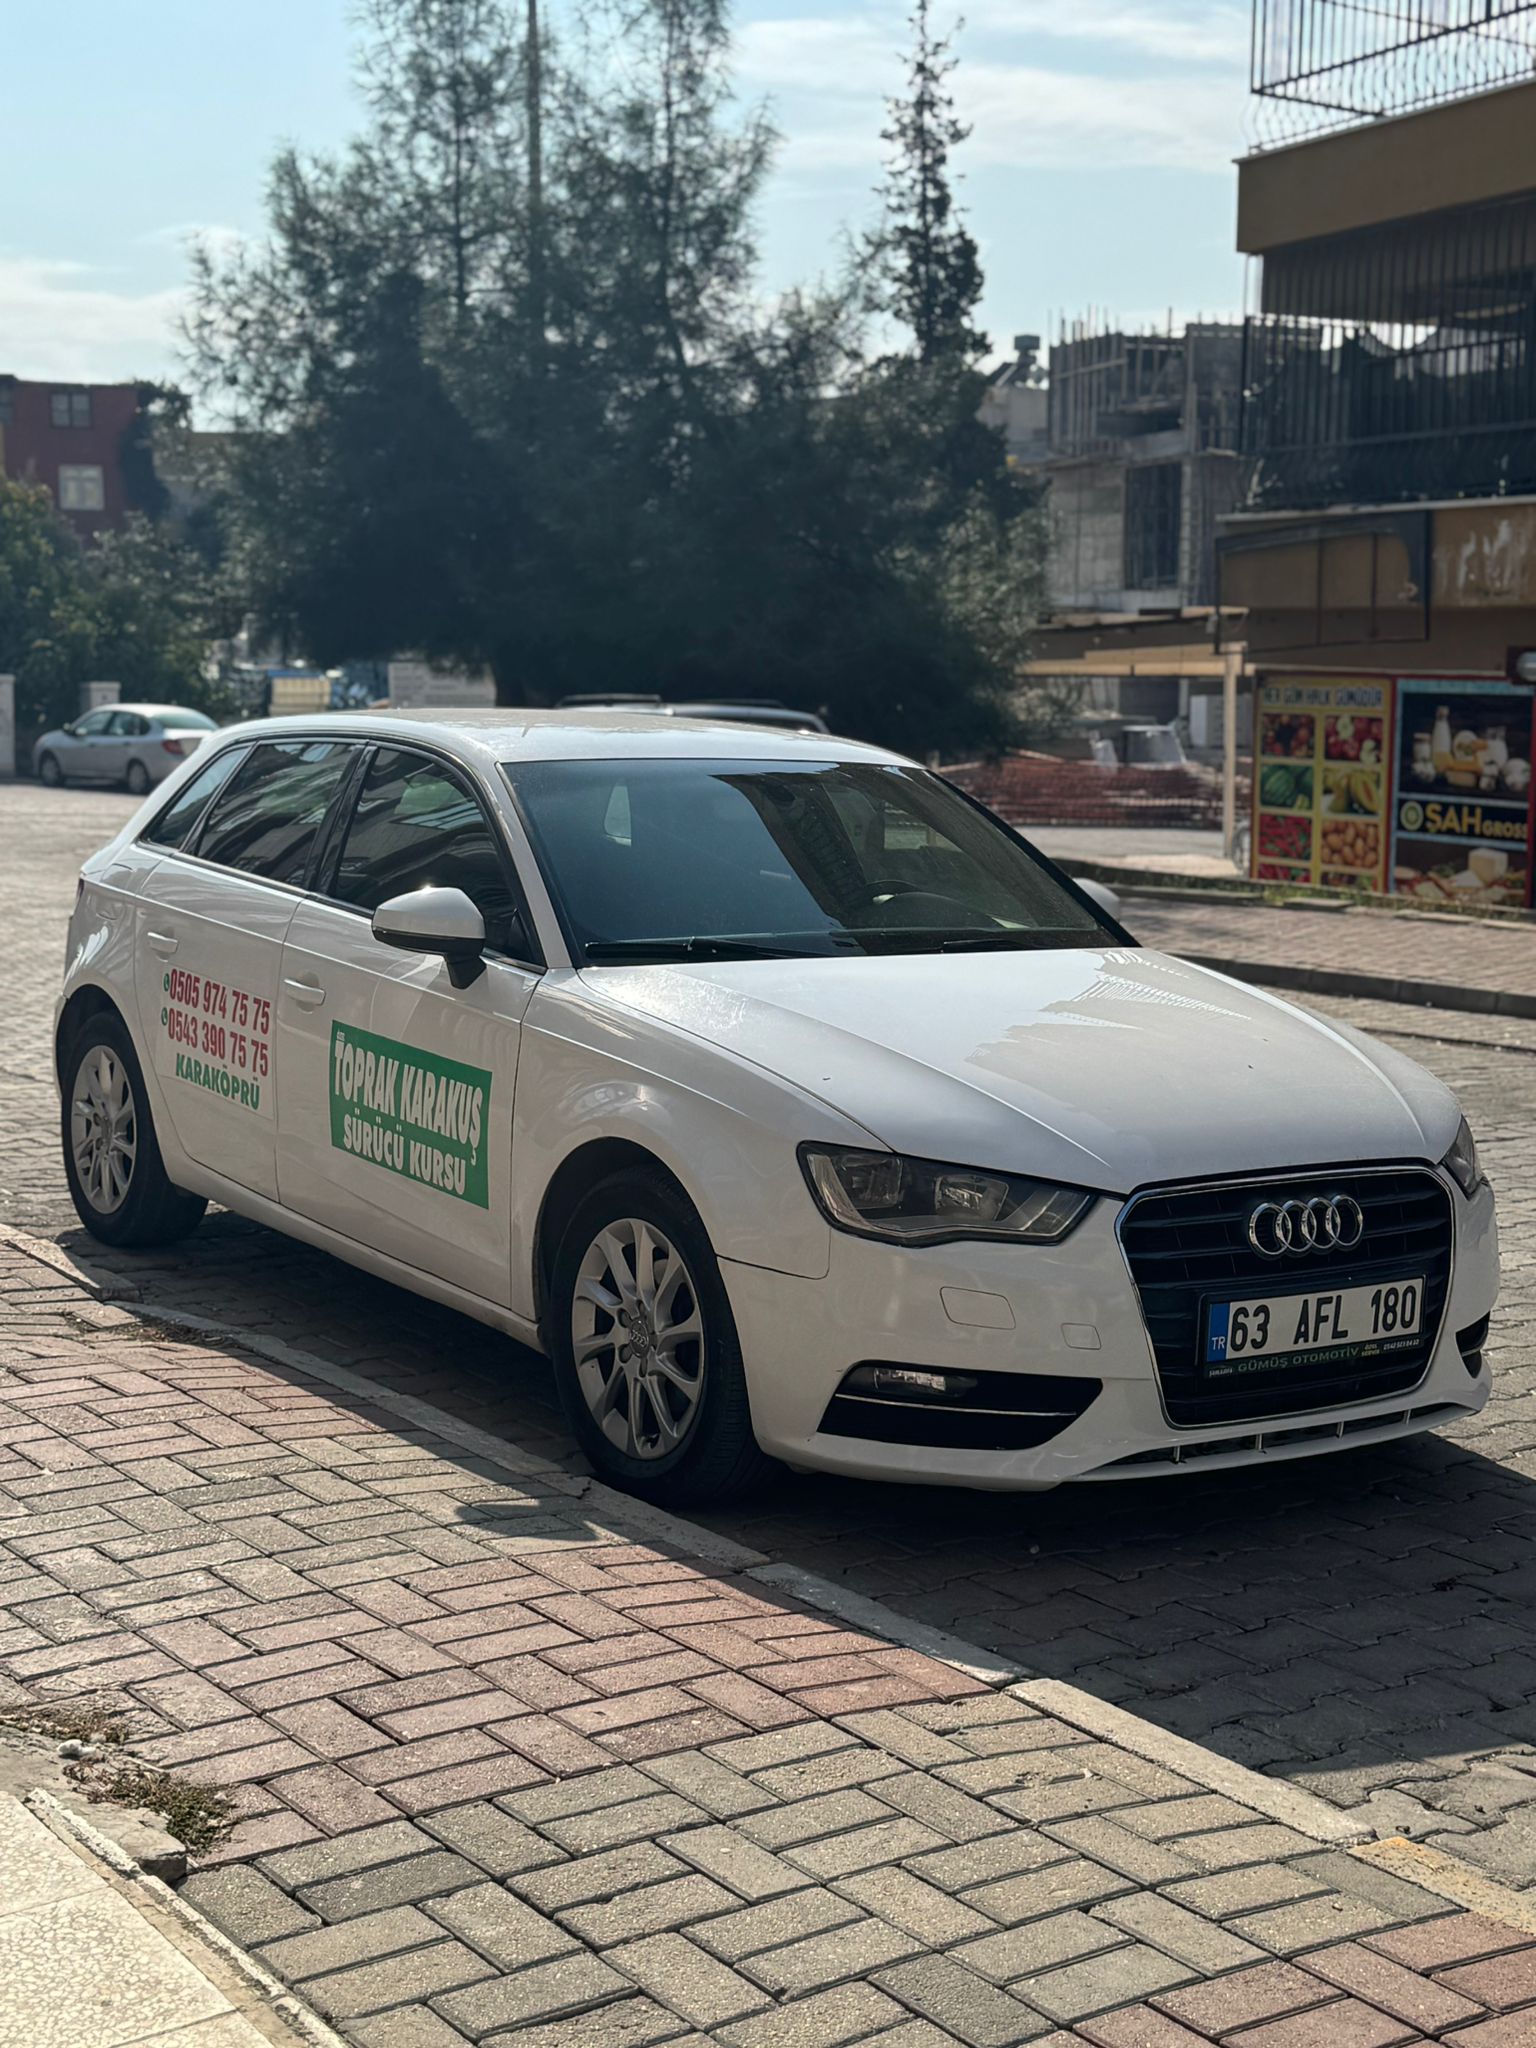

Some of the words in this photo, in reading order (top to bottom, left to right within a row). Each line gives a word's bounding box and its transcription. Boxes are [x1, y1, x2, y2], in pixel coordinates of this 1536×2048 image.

[169, 968, 200, 1008] 0505
[203, 980, 227, 1019] 974
[232, 990, 249, 1026] 75
[253, 997, 270, 1035] 75
[168, 1008, 198, 1048] 0543
[202, 1021, 226, 1060] 390
[230, 1031, 246, 1068] 75
[251, 1039, 268, 1077] 75
[176, 1053, 260, 1110] KARAKÖPRÜ
[335, 1039, 400, 1117] TOPRAK
[400, 1064, 483, 1166] KARAKUŞ
[343, 1107, 404, 1170] SÜRÜCÜ
[410, 1140, 466, 1195] KURSU
[1211, 1336, 1226, 1350] TR
[1230, 1304, 1271, 1352] 63
[1293, 1295, 1348, 1345] AFL
[1371, 1285, 1416, 1334] 180
[1238, 1356, 1289, 1372] GÜMÜŞ
[1293, 1346, 1360, 1364] OTOMOTİV
